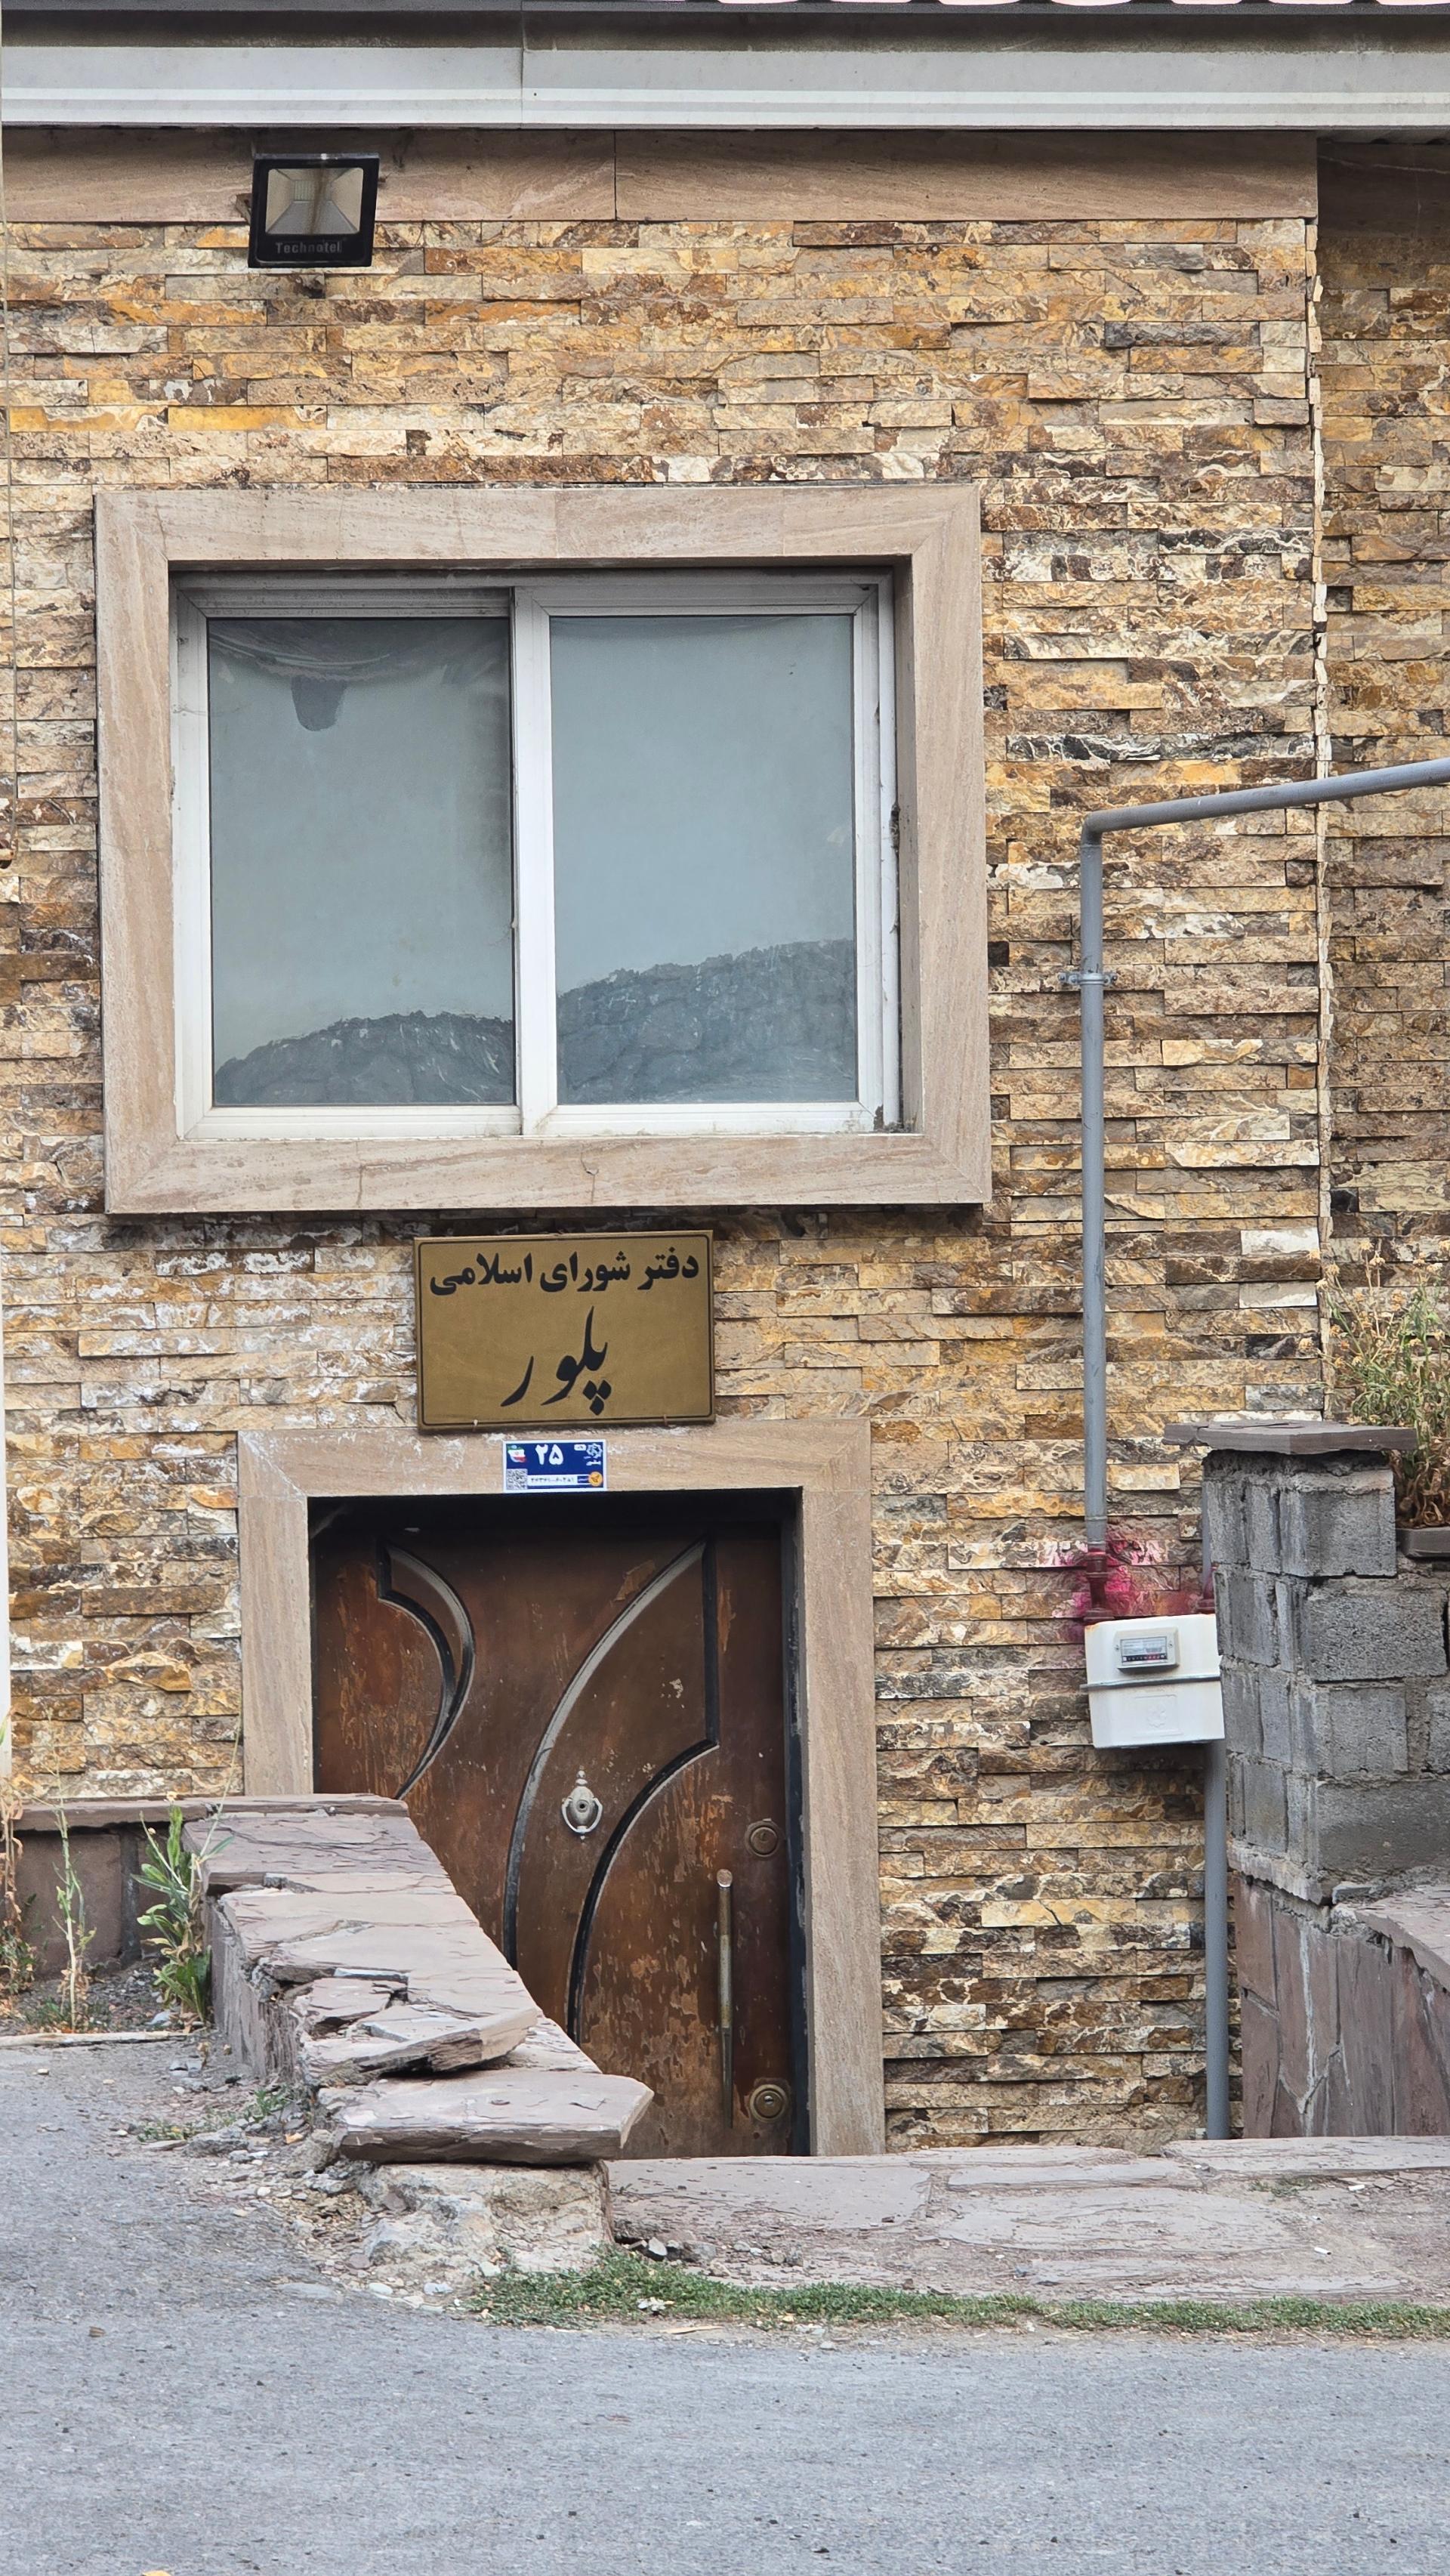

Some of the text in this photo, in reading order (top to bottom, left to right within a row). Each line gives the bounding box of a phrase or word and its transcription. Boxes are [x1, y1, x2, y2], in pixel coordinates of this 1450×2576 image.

[275, 240, 344, 254] Technotel
[429, 1246, 699, 1296] دفتر شورای اسلامی
[500, 1305, 612, 1416] پلور
[535, 1444, 564, 1466] ۲۵
